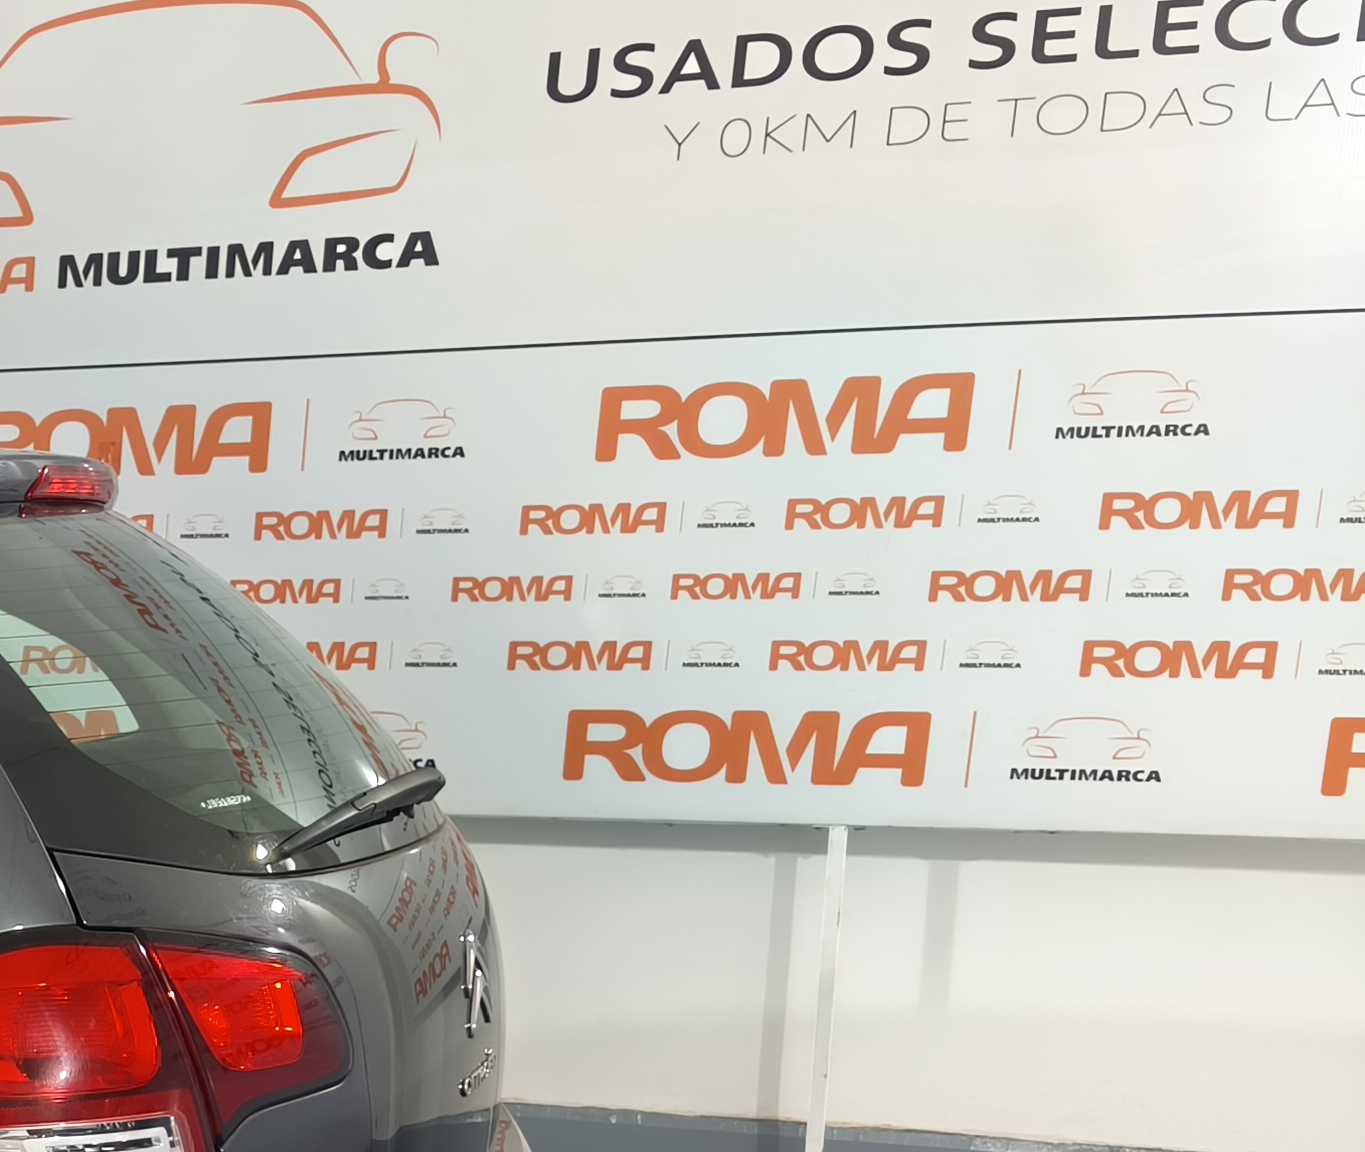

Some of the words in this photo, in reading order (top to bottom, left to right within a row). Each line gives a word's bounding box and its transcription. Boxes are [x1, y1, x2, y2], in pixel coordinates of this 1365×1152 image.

[546, 18, 933, 104] USADOS
[664, 122, 700, 161] Y
[885, 100, 973, 147] DE
[997, 82, 1236, 138] TODAS
[57, 230, 440, 290] MULTIMARCA
[595, 372, 976, 464] ROMA
[1054, 423, 1210, 440] MULTIMARCA
[338, 445, 466, 463] MULTIMARCA
[254, 509, 389, 543] ROMA
[519, 502, 668, 537] ROMA
[784, 496, 946, 532] ROMA
[1098, 490, 1300, 532] ROMA
[230, 578, 342, 606] ROMA
[451, 575, 574, 604] ROMA
[670, 572, 803, 602] ROMA
[928, 569, 1093, 605] ROMA
[1221, 568, 1365, 603] ROM
[507, 641, 654, 673] ROMA
[768, 640, 928, 674] ROMA
[1079, 640, 1280, 681] ROMA
[562, 709, 933, 789] ROMA
[1009, 767, 1163, 784] MULTIMARCA
